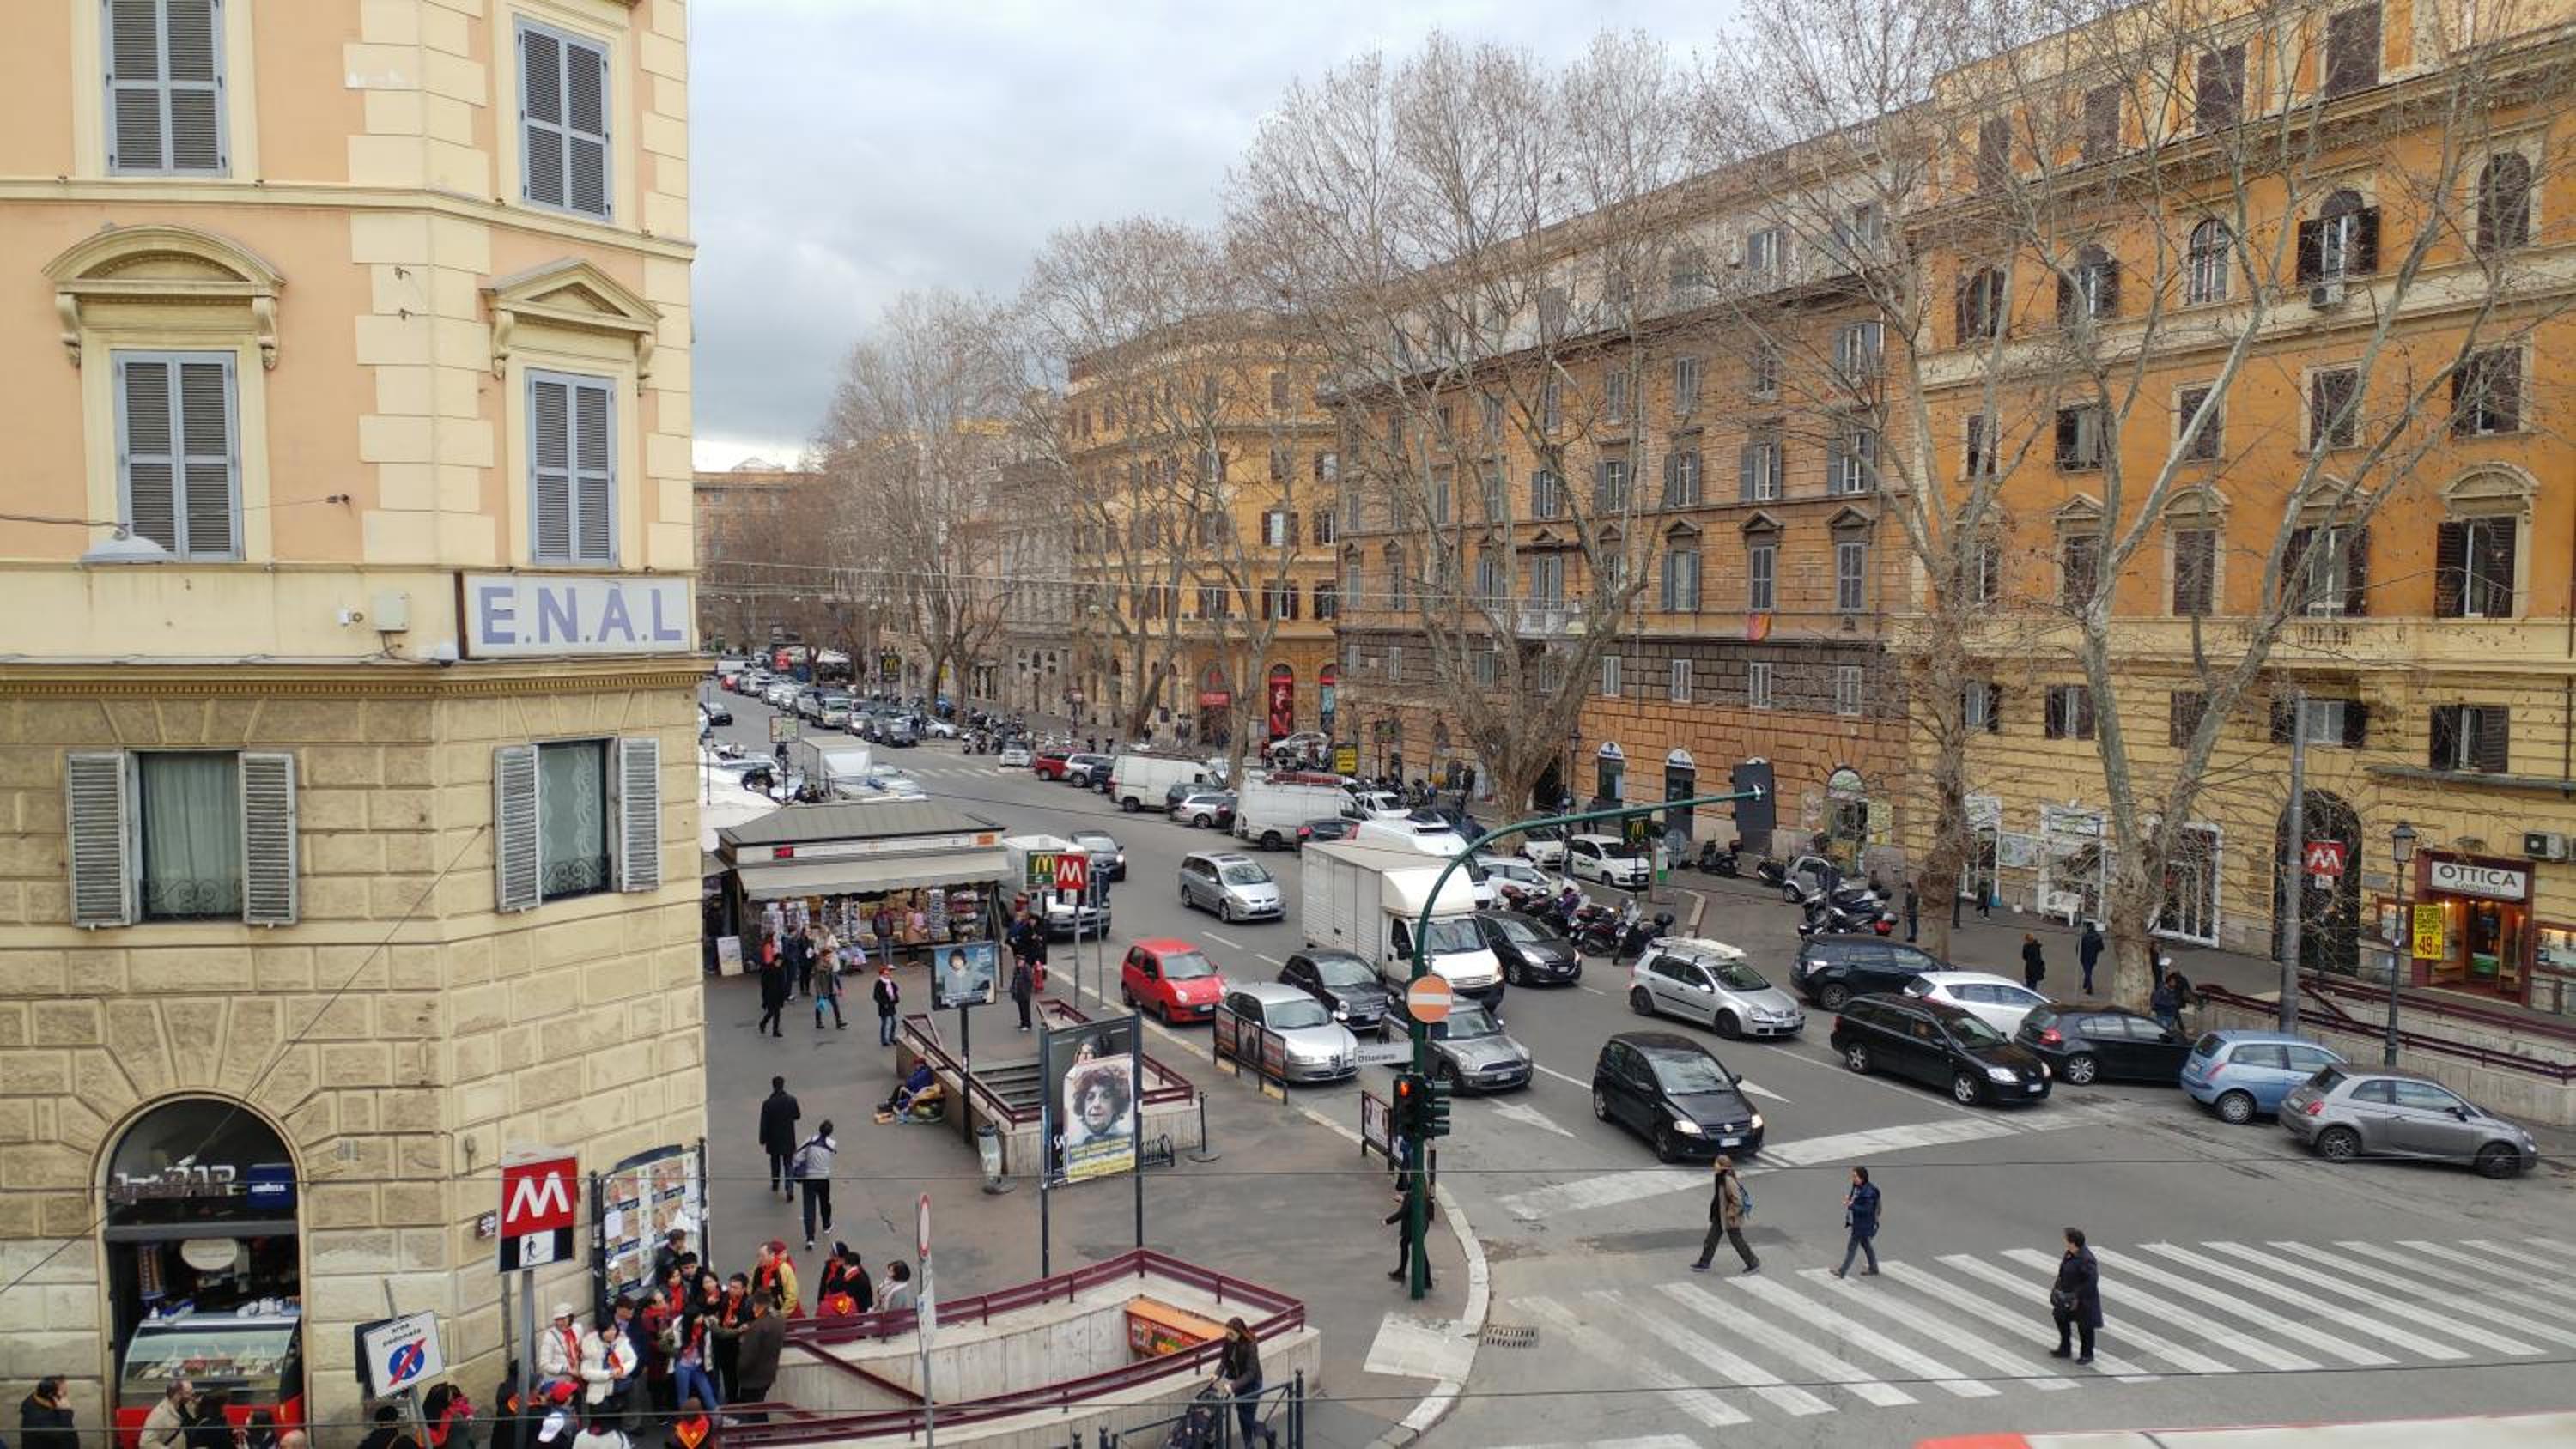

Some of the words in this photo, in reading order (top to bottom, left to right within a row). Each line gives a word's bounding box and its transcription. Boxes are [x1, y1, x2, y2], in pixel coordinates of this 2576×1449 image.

[1058, 860, 1084, 884] M
[2439, 864, 2517, 888] OTTICA
[506, 1170, 570, 1223] M
